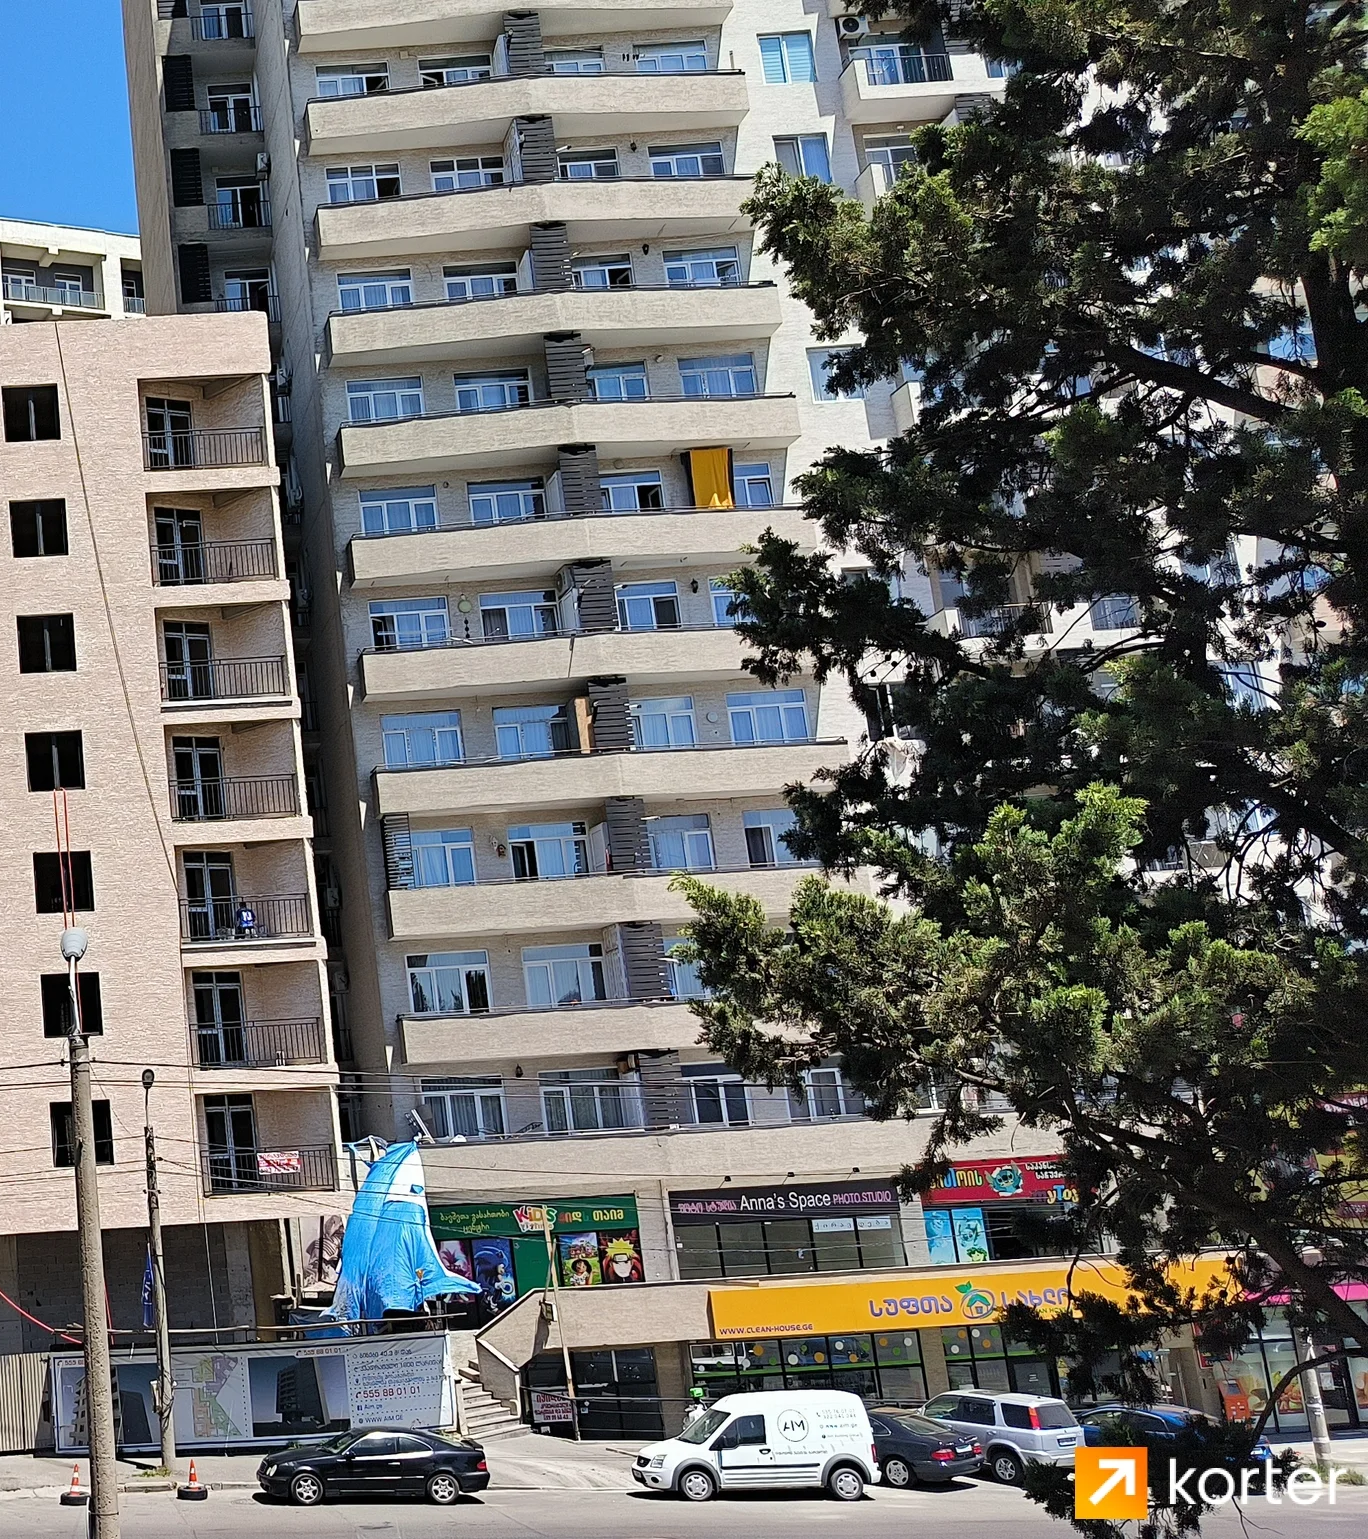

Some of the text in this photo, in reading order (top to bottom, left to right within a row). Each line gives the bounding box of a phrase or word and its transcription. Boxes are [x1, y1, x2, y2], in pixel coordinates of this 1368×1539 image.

[740, 1190, 891, 1212] Anna's Space PHOTO STUDIO
[593, 1209, 624, 1221] თაიმ
[869, 1296, 953, 1317] სუფთა
[363, 1386, 420, 1398] 555 88 01 01
